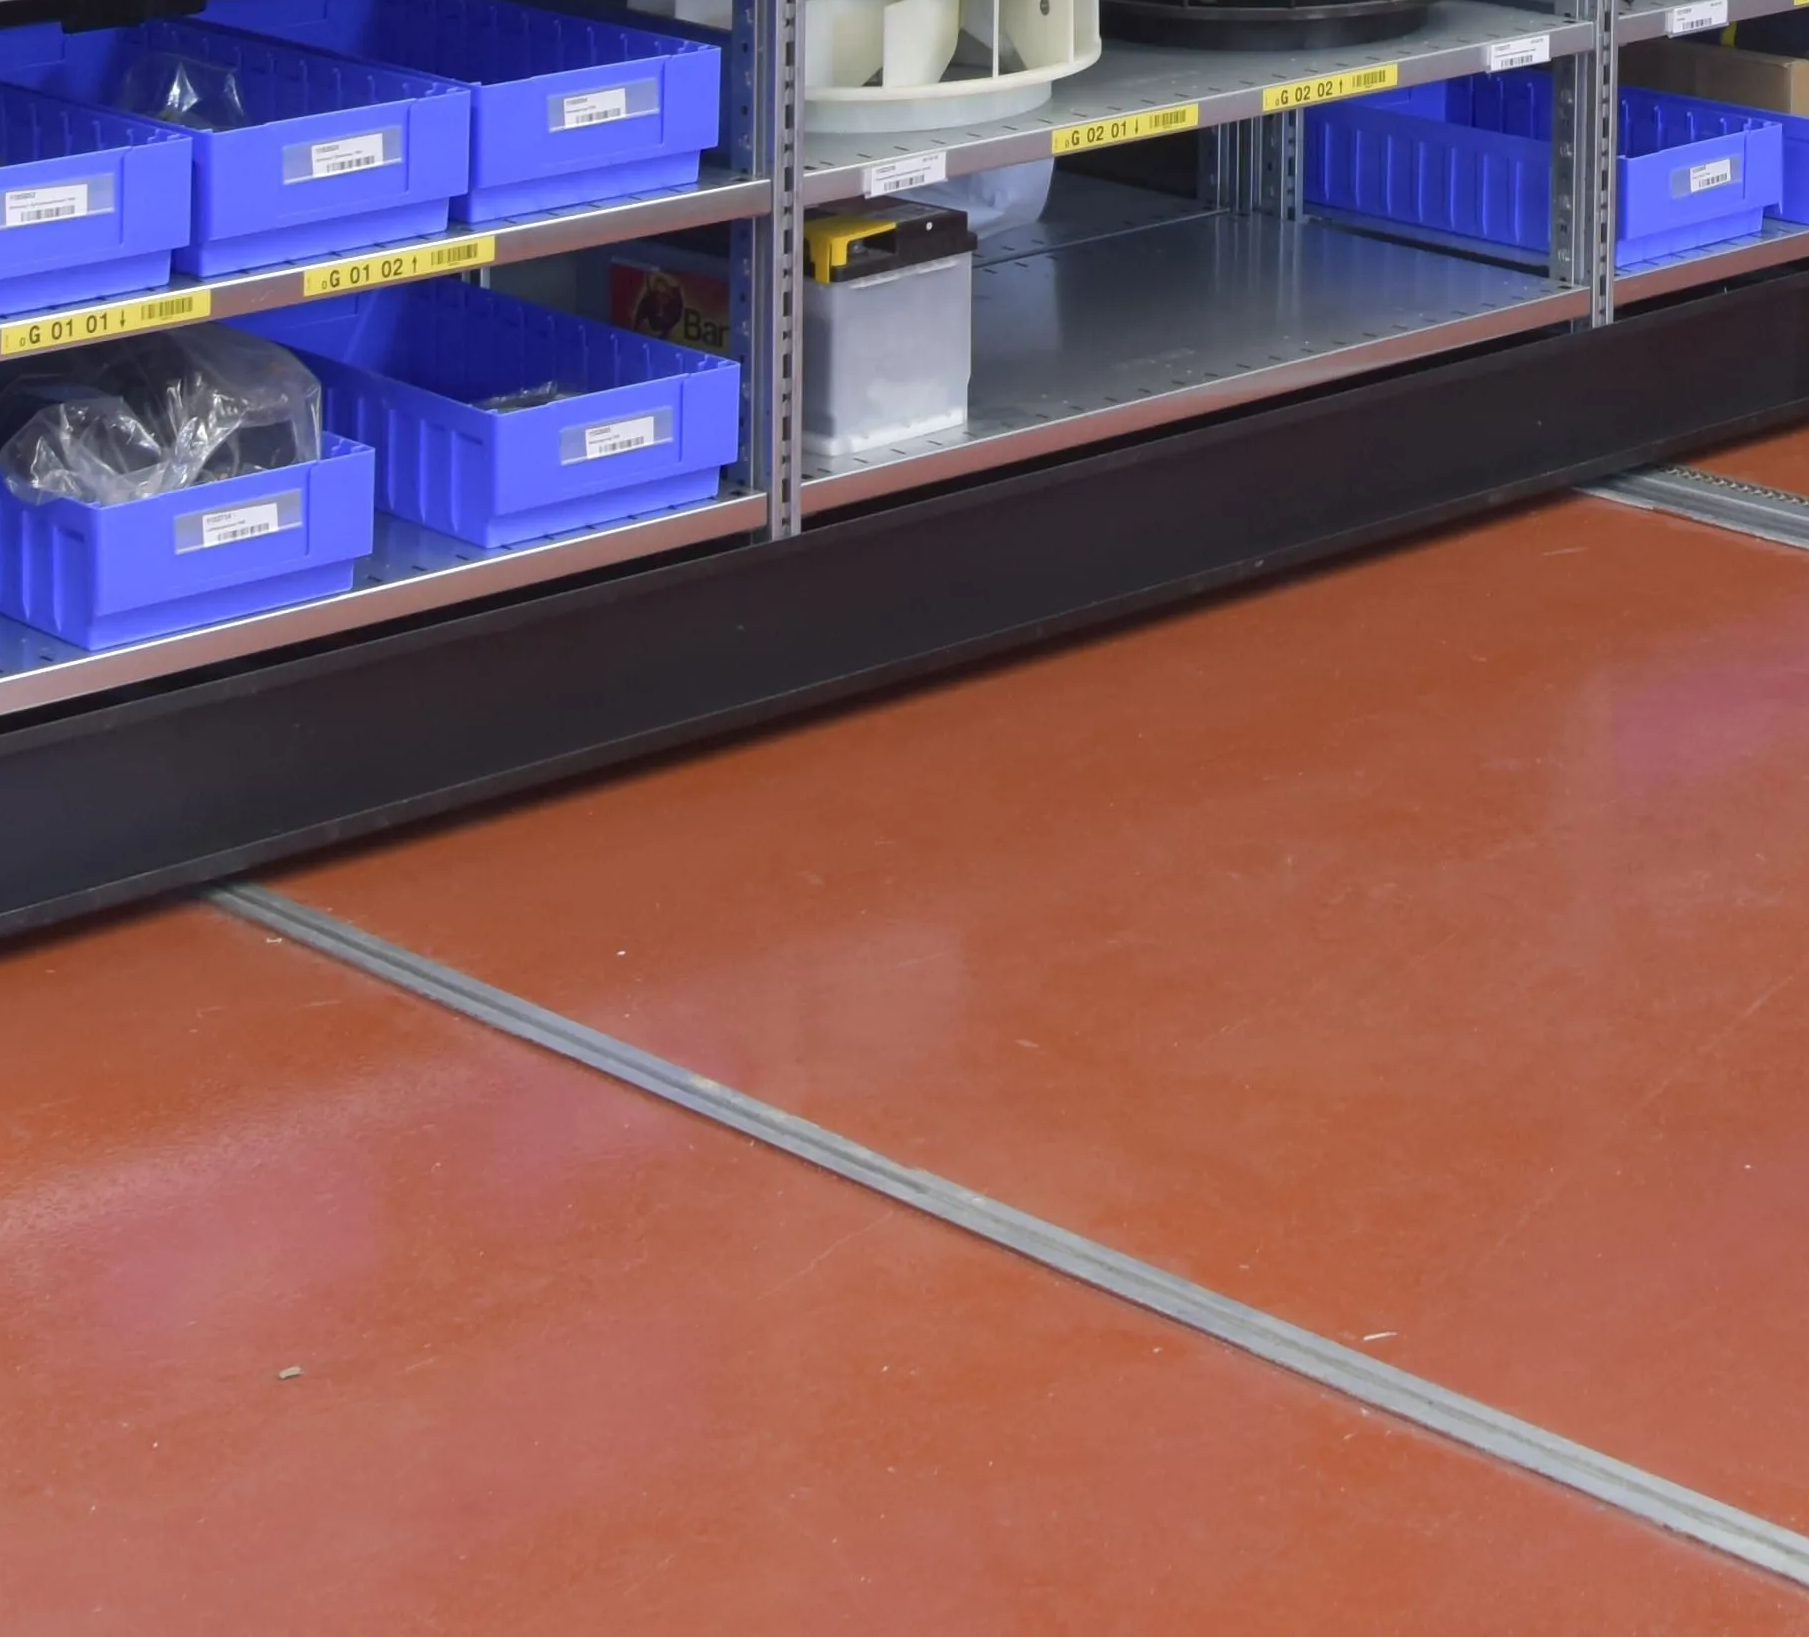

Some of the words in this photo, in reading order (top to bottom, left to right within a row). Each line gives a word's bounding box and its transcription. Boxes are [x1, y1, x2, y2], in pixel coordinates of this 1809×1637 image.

[1294, 85, 1311, 103] 02
[1317, 80, 1333, 98] 02
[1086, 125, 1104, 144] 02
[1111, 120, 1127, 139] 01
[349, 264, 370, 285] 01
[381, 257, 403, 279] 02
[51, 319, 73, 341] 01
[85, 313, 107, 334] 01
